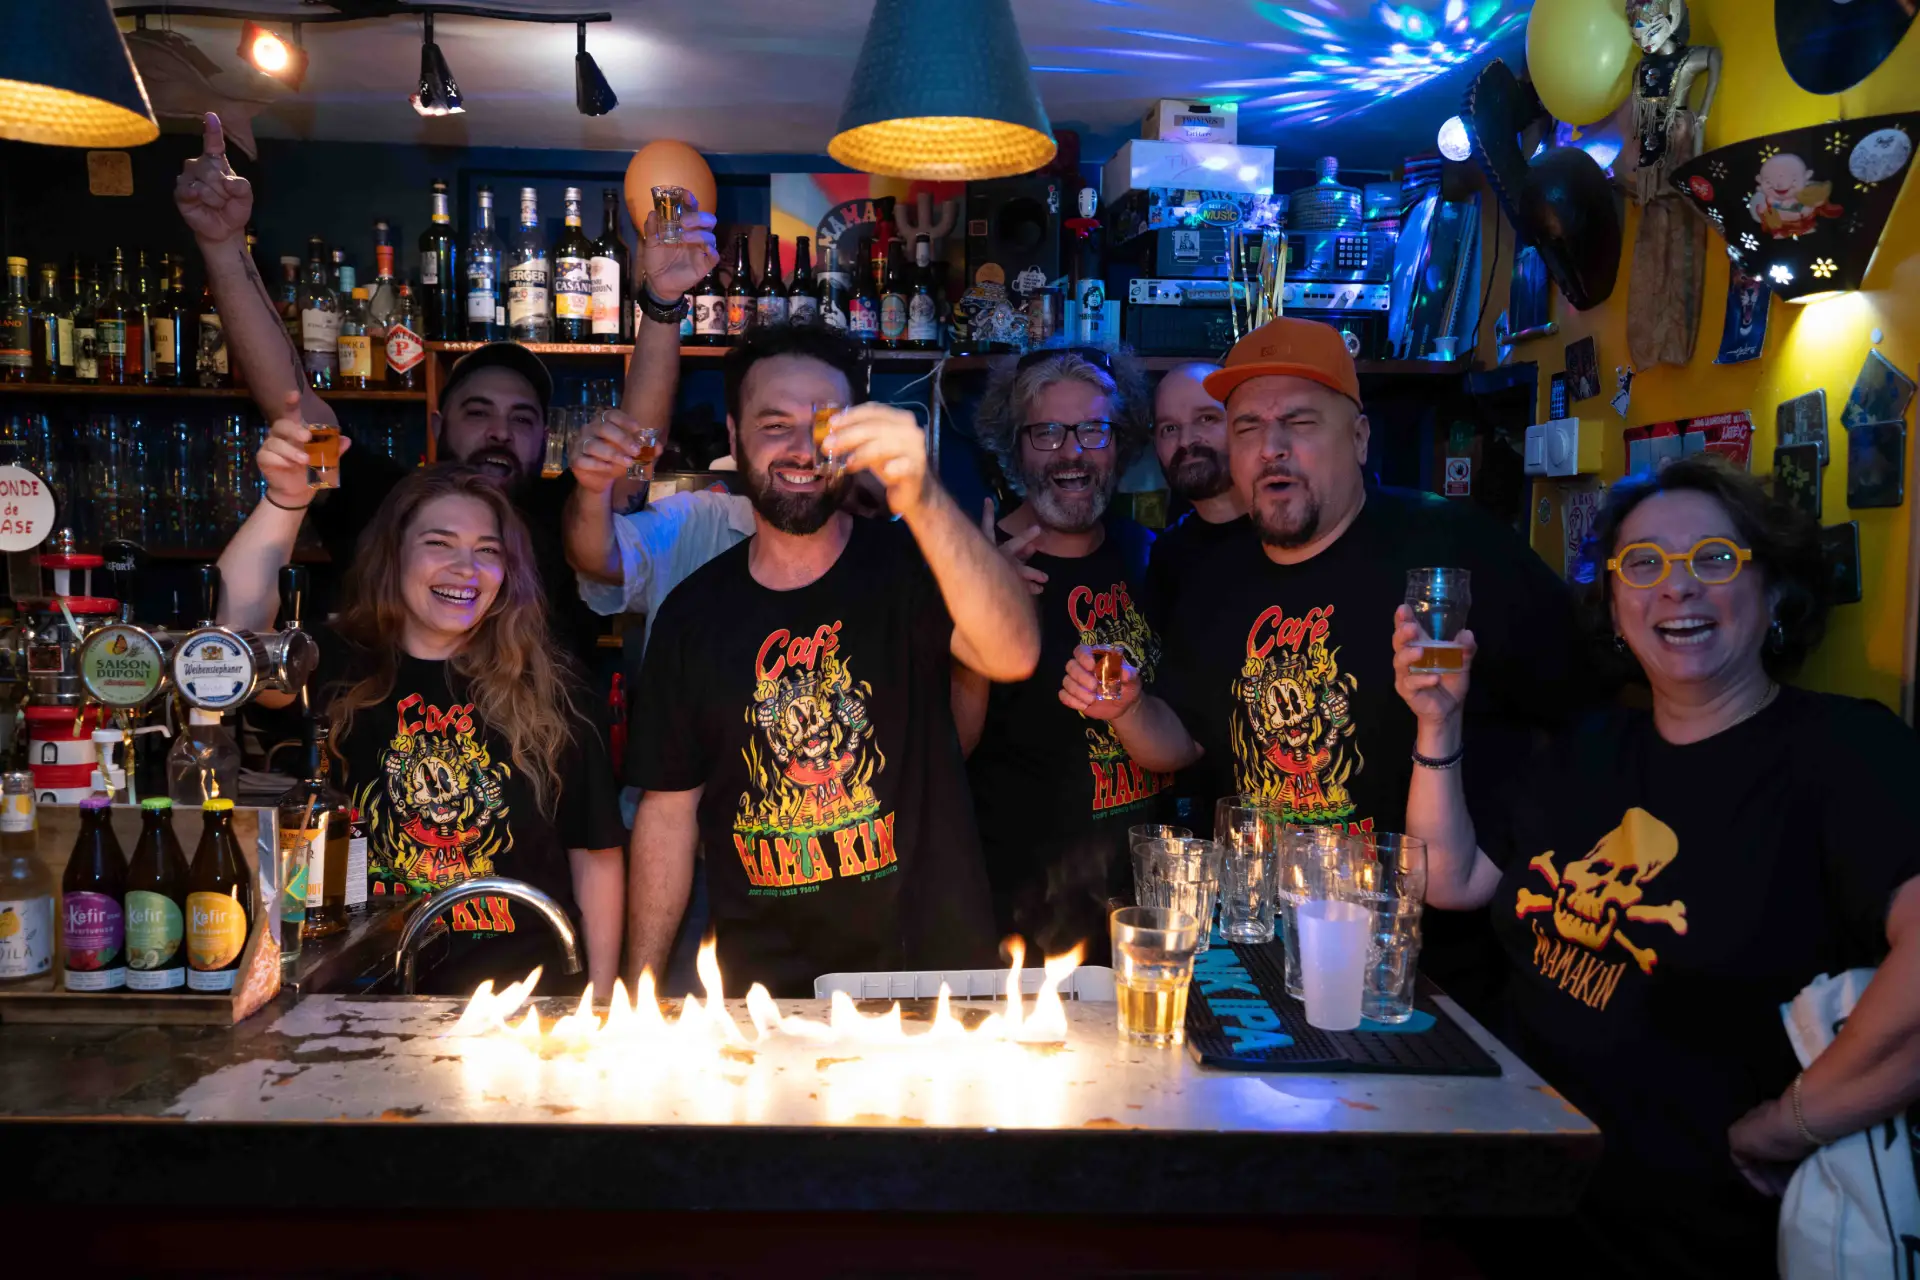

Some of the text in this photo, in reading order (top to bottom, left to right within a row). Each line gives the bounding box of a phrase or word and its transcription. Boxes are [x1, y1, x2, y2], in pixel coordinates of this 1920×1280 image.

[1203, 209, 1237, 221] MUSIC
[509, 270, 545, 281] BERGER
[556, 280, 592, 291] CASANI
[0, 319, 22, 328] LAND
[0, 480, 39, 496] ONDE
[4, 502, 18, 516] de
[0, 519, 33, 534] ASE
[1068, 580, 1131, 632] Café
[1247, 604, 1334, 659] Café
[755, 620, 842, 682] Café
[96, 660, 150, 669] SAISON
[184, 663, 243, 676] Weihenstephaner
[97, 669, 151, 679] DUPONT
[397, 693, 475, 737] Café
[733, 812, 898, 887] MAMA KIN
[1533, 918, 1626, 1011] MAMAKIN
[1208, 998, 1296, 1053] IPA
